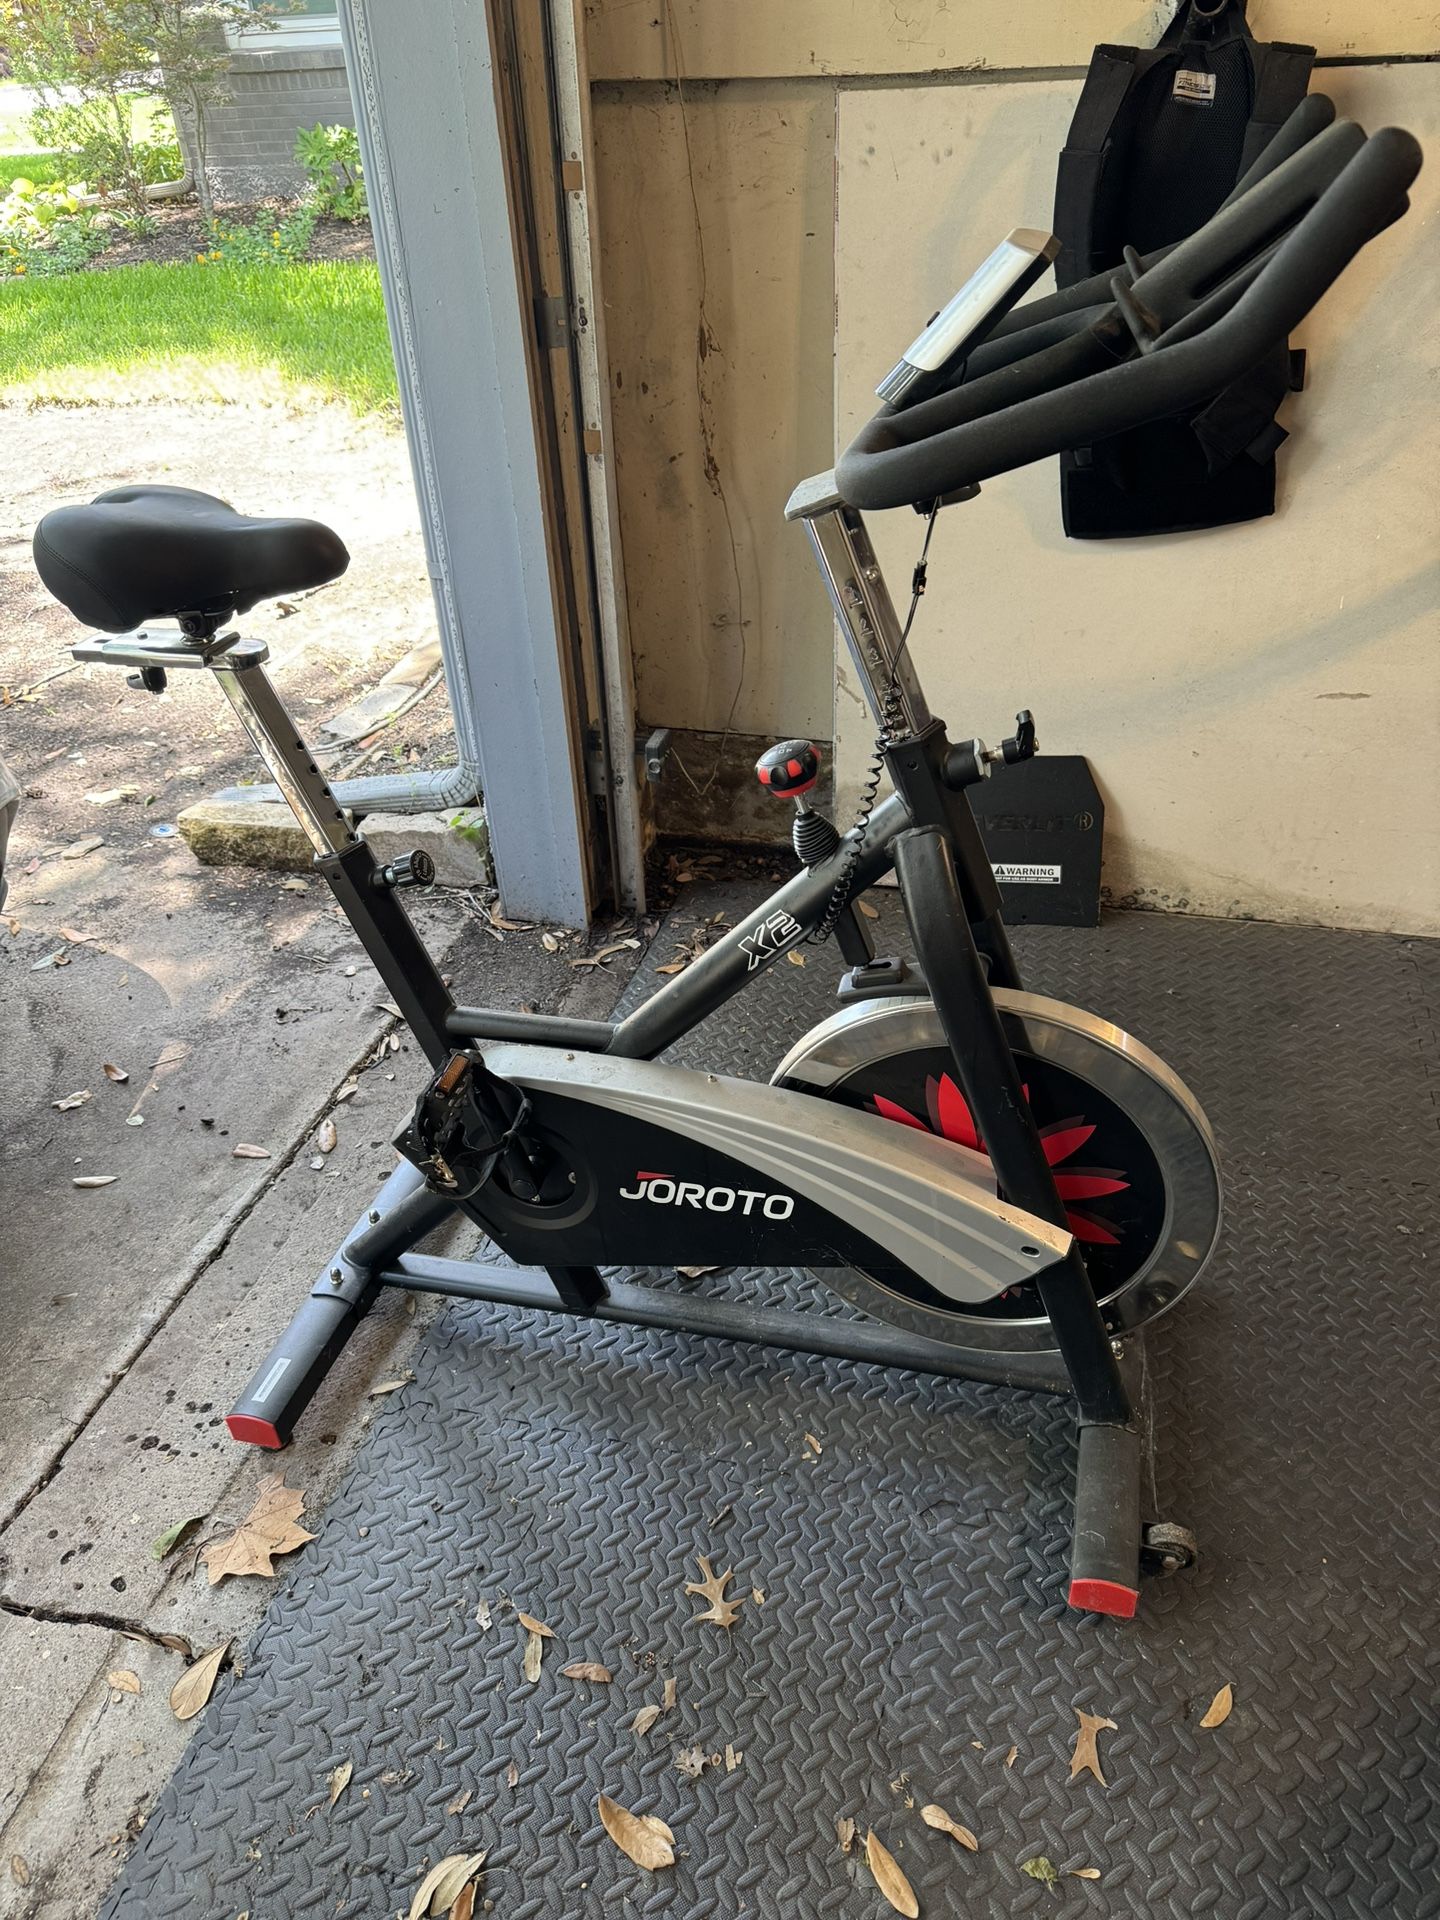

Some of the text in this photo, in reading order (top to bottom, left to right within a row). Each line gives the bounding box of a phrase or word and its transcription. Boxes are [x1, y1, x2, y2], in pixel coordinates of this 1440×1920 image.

[1006, 867, 1055, 876] WARNING
[738, 909, 802, 971] X2
[619, 1172, 795, 1220] JOROTO
